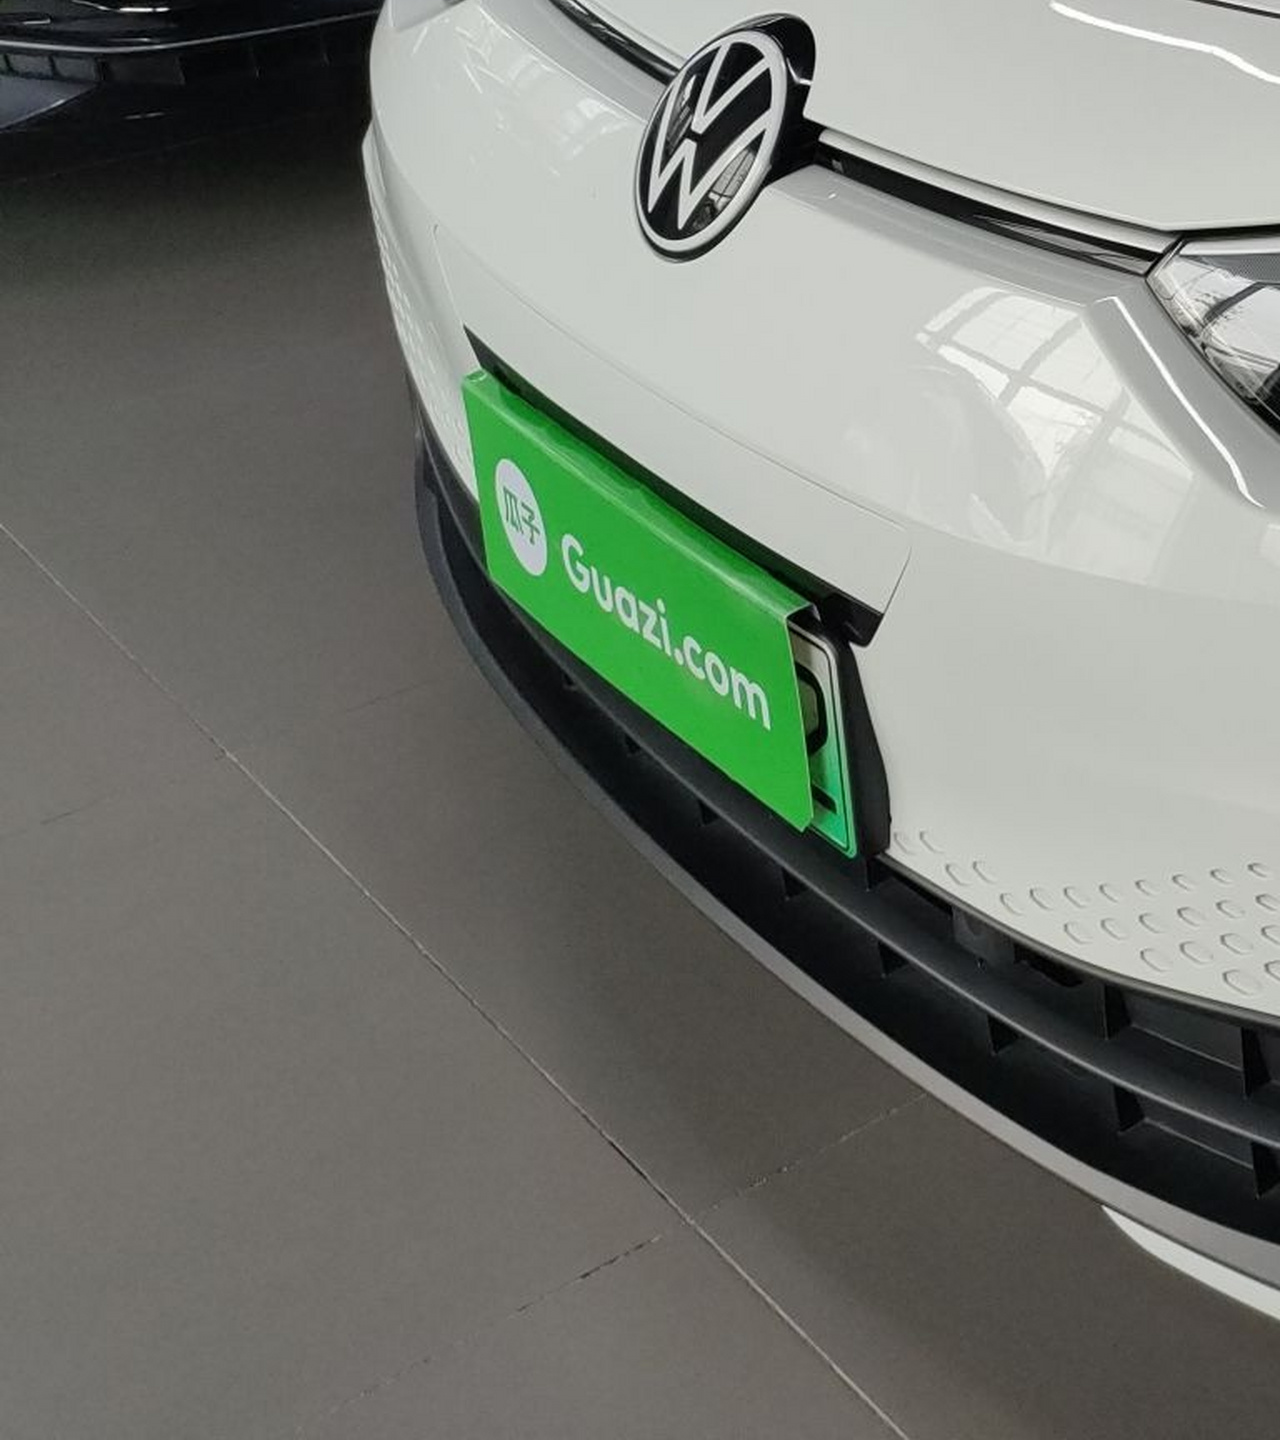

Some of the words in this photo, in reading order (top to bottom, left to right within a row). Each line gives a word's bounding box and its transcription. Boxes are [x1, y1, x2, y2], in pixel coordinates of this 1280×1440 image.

[645, 35, 777, 232] VW
[502, 485, 541, 546] 瓜子
[561, 533, 772, 731] Guazi.com
